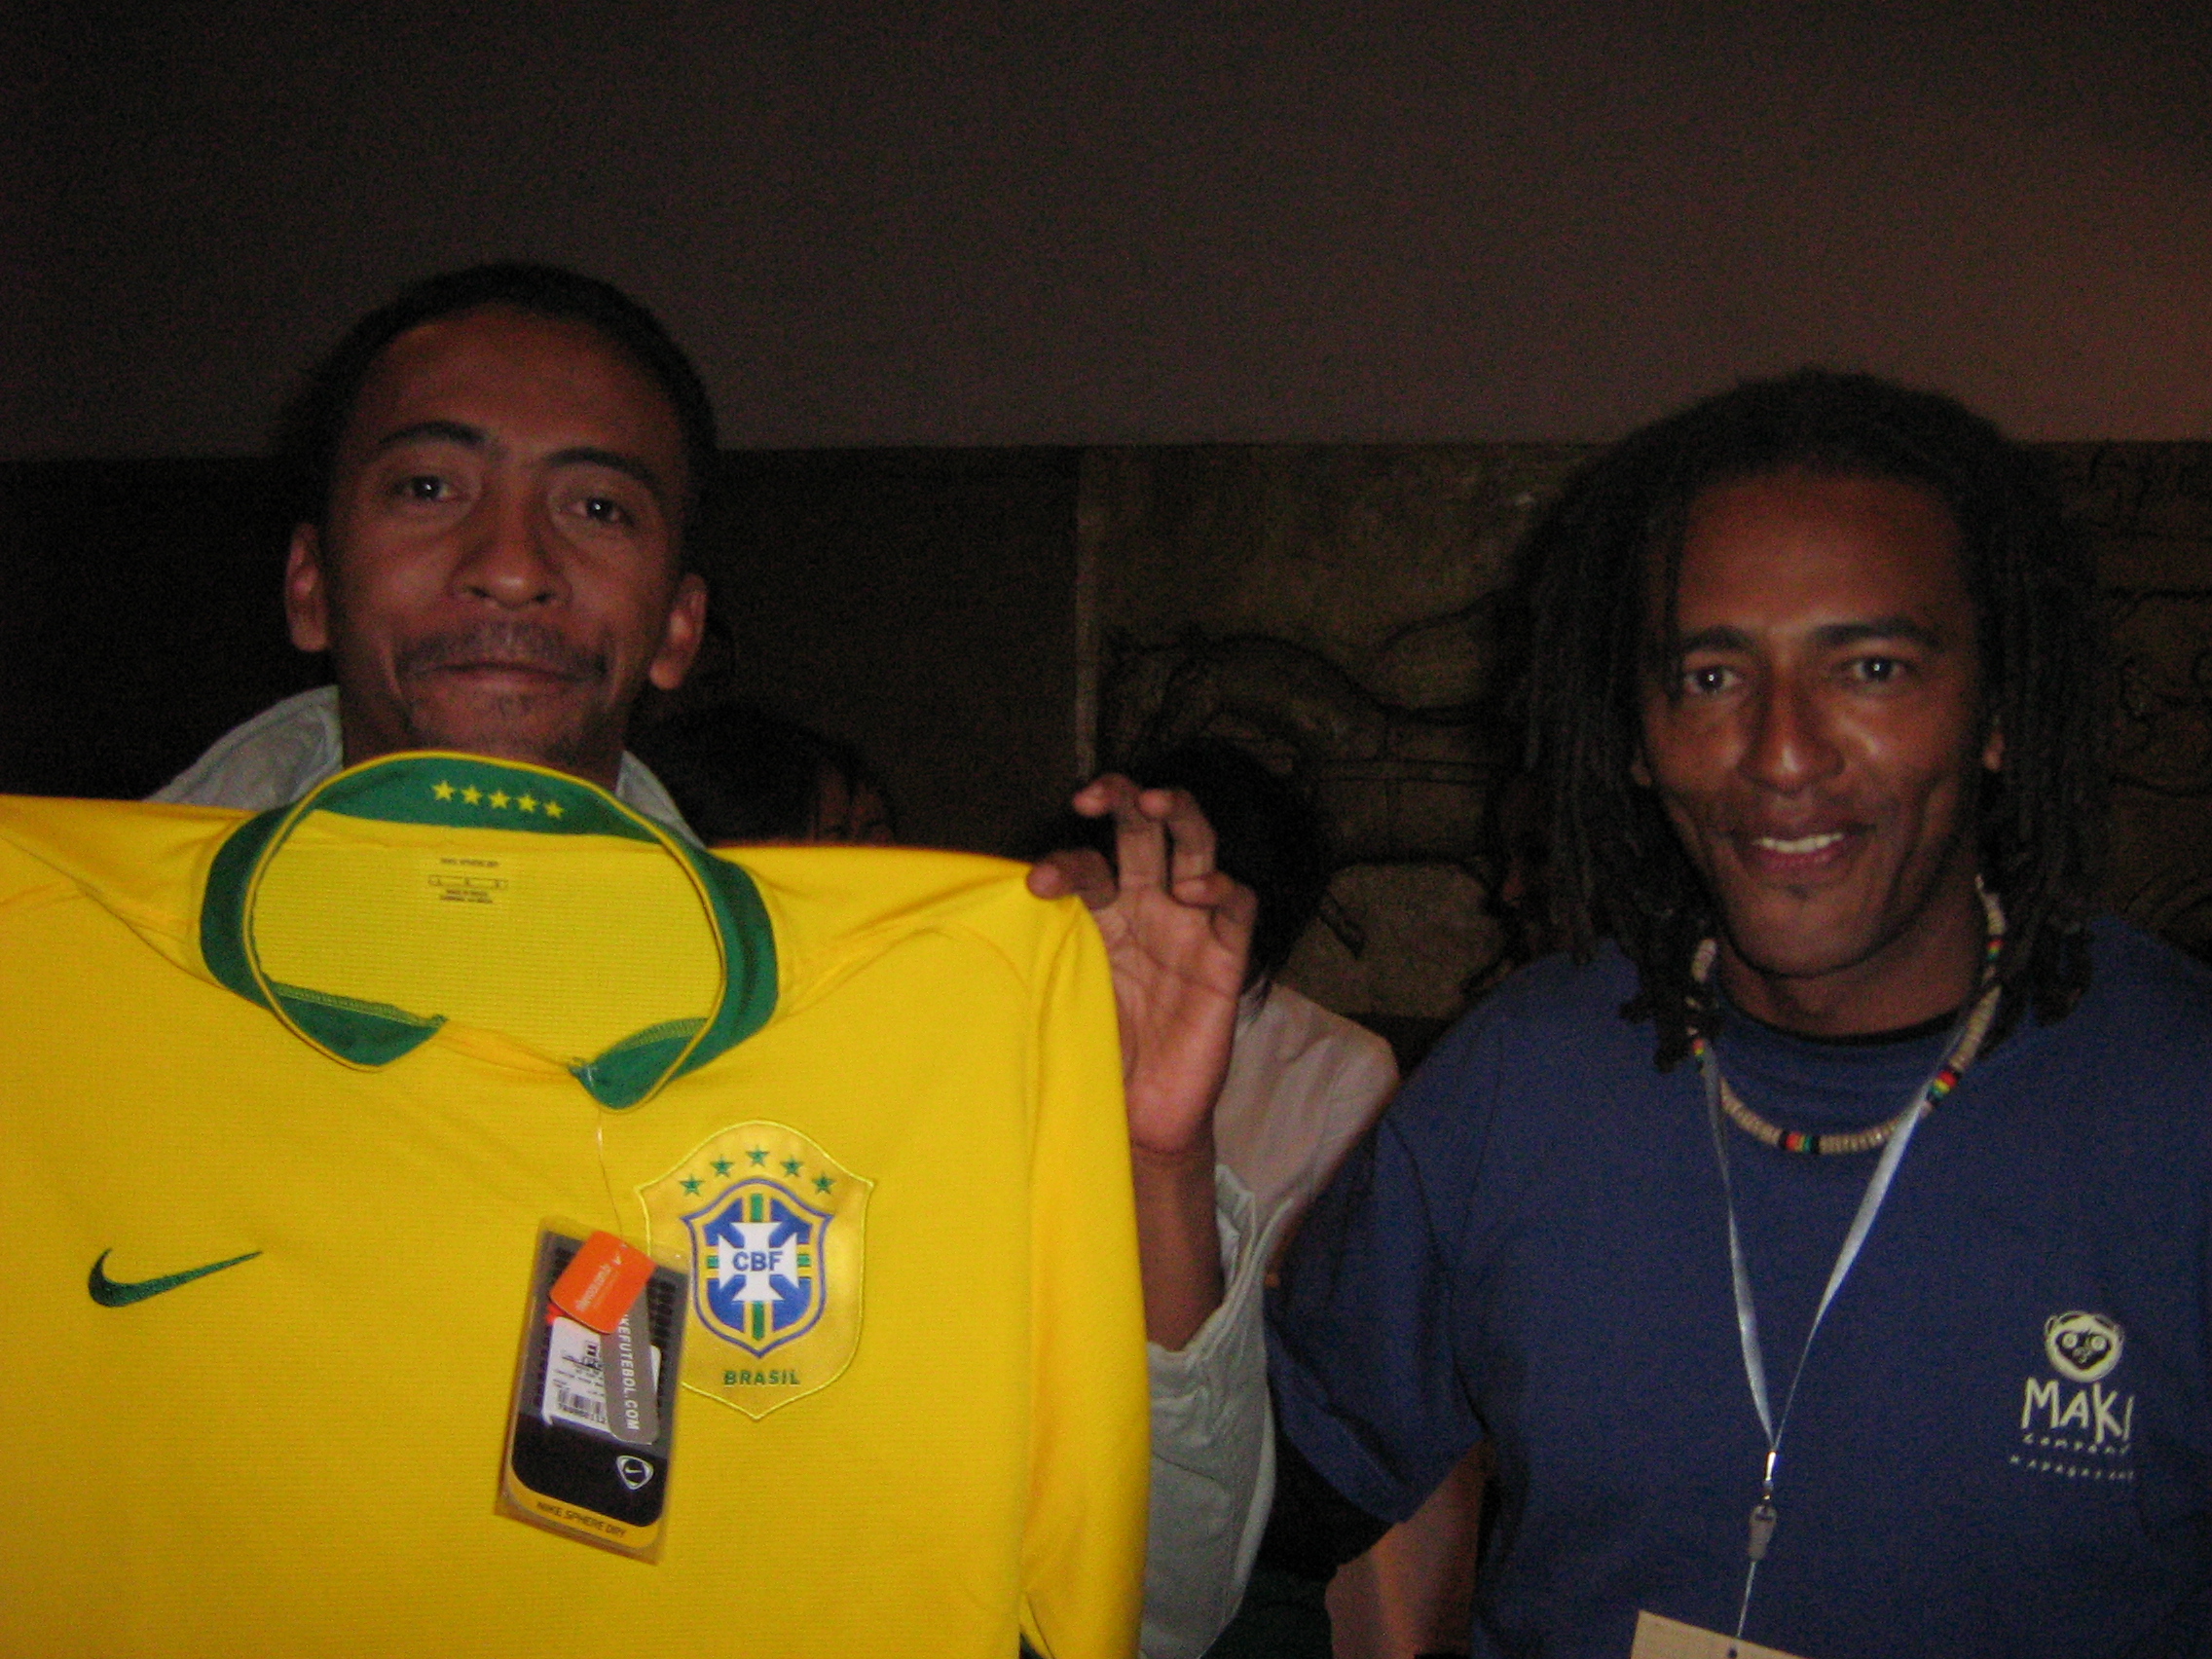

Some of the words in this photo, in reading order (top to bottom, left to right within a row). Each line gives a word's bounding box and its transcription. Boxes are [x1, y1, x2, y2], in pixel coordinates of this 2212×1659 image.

[732, 1250, 784, 1272] CBF
[618, 1313, 640, 1431] KEFUTEBOL.COM
[722, 1370, 801, 1386] BRASIL
[2020, 1376, 2136, 1445] MAKI
